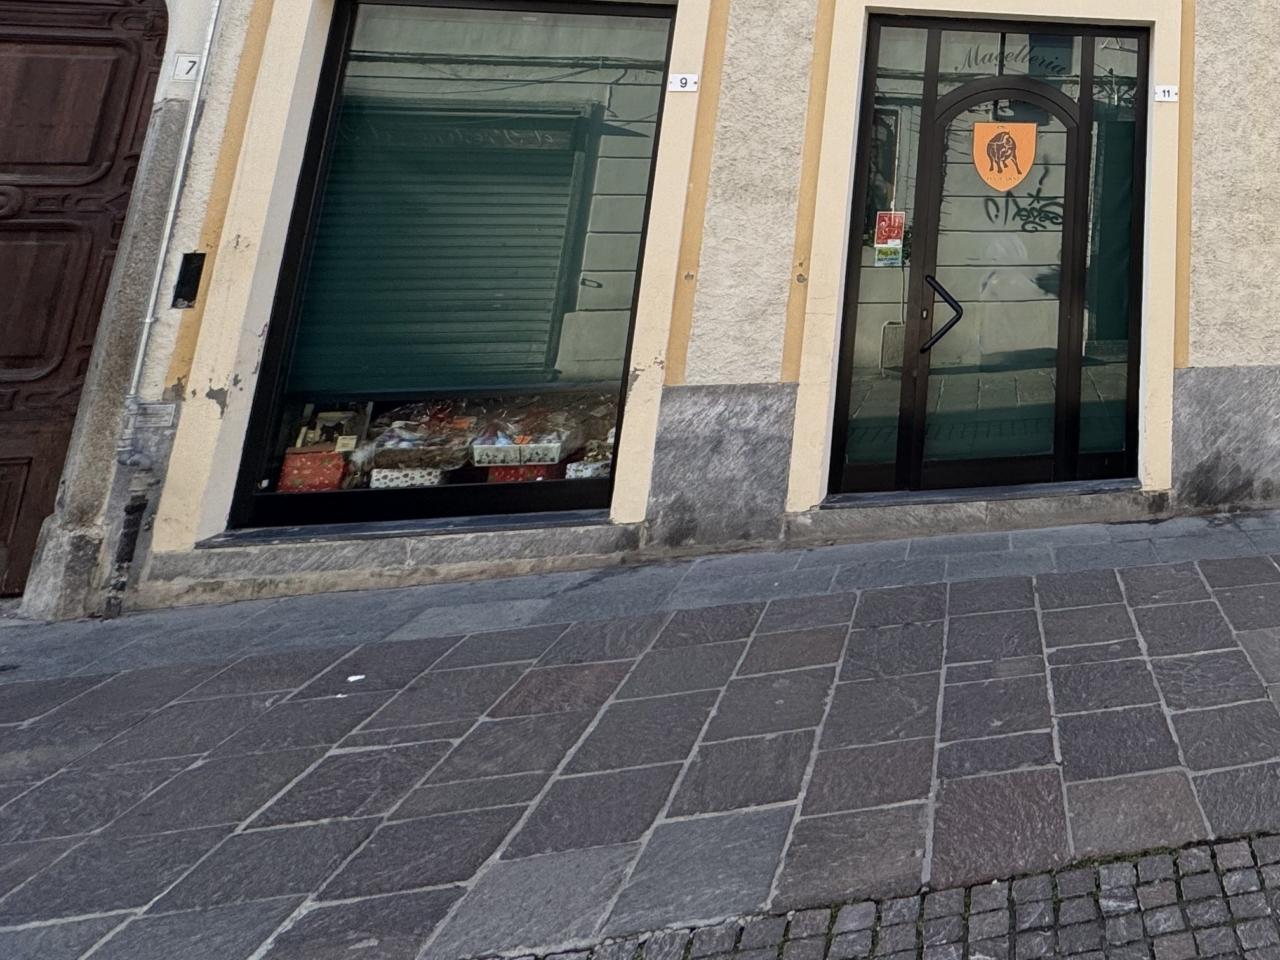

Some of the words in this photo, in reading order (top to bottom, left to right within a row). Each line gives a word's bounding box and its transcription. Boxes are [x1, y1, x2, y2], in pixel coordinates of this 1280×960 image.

[954, 44, 1067, 75] Macelleria
[185, 60, 197, 75] 7
[679, 76, 688, 89] 9
[1162, 89, 1171, 98] 11
